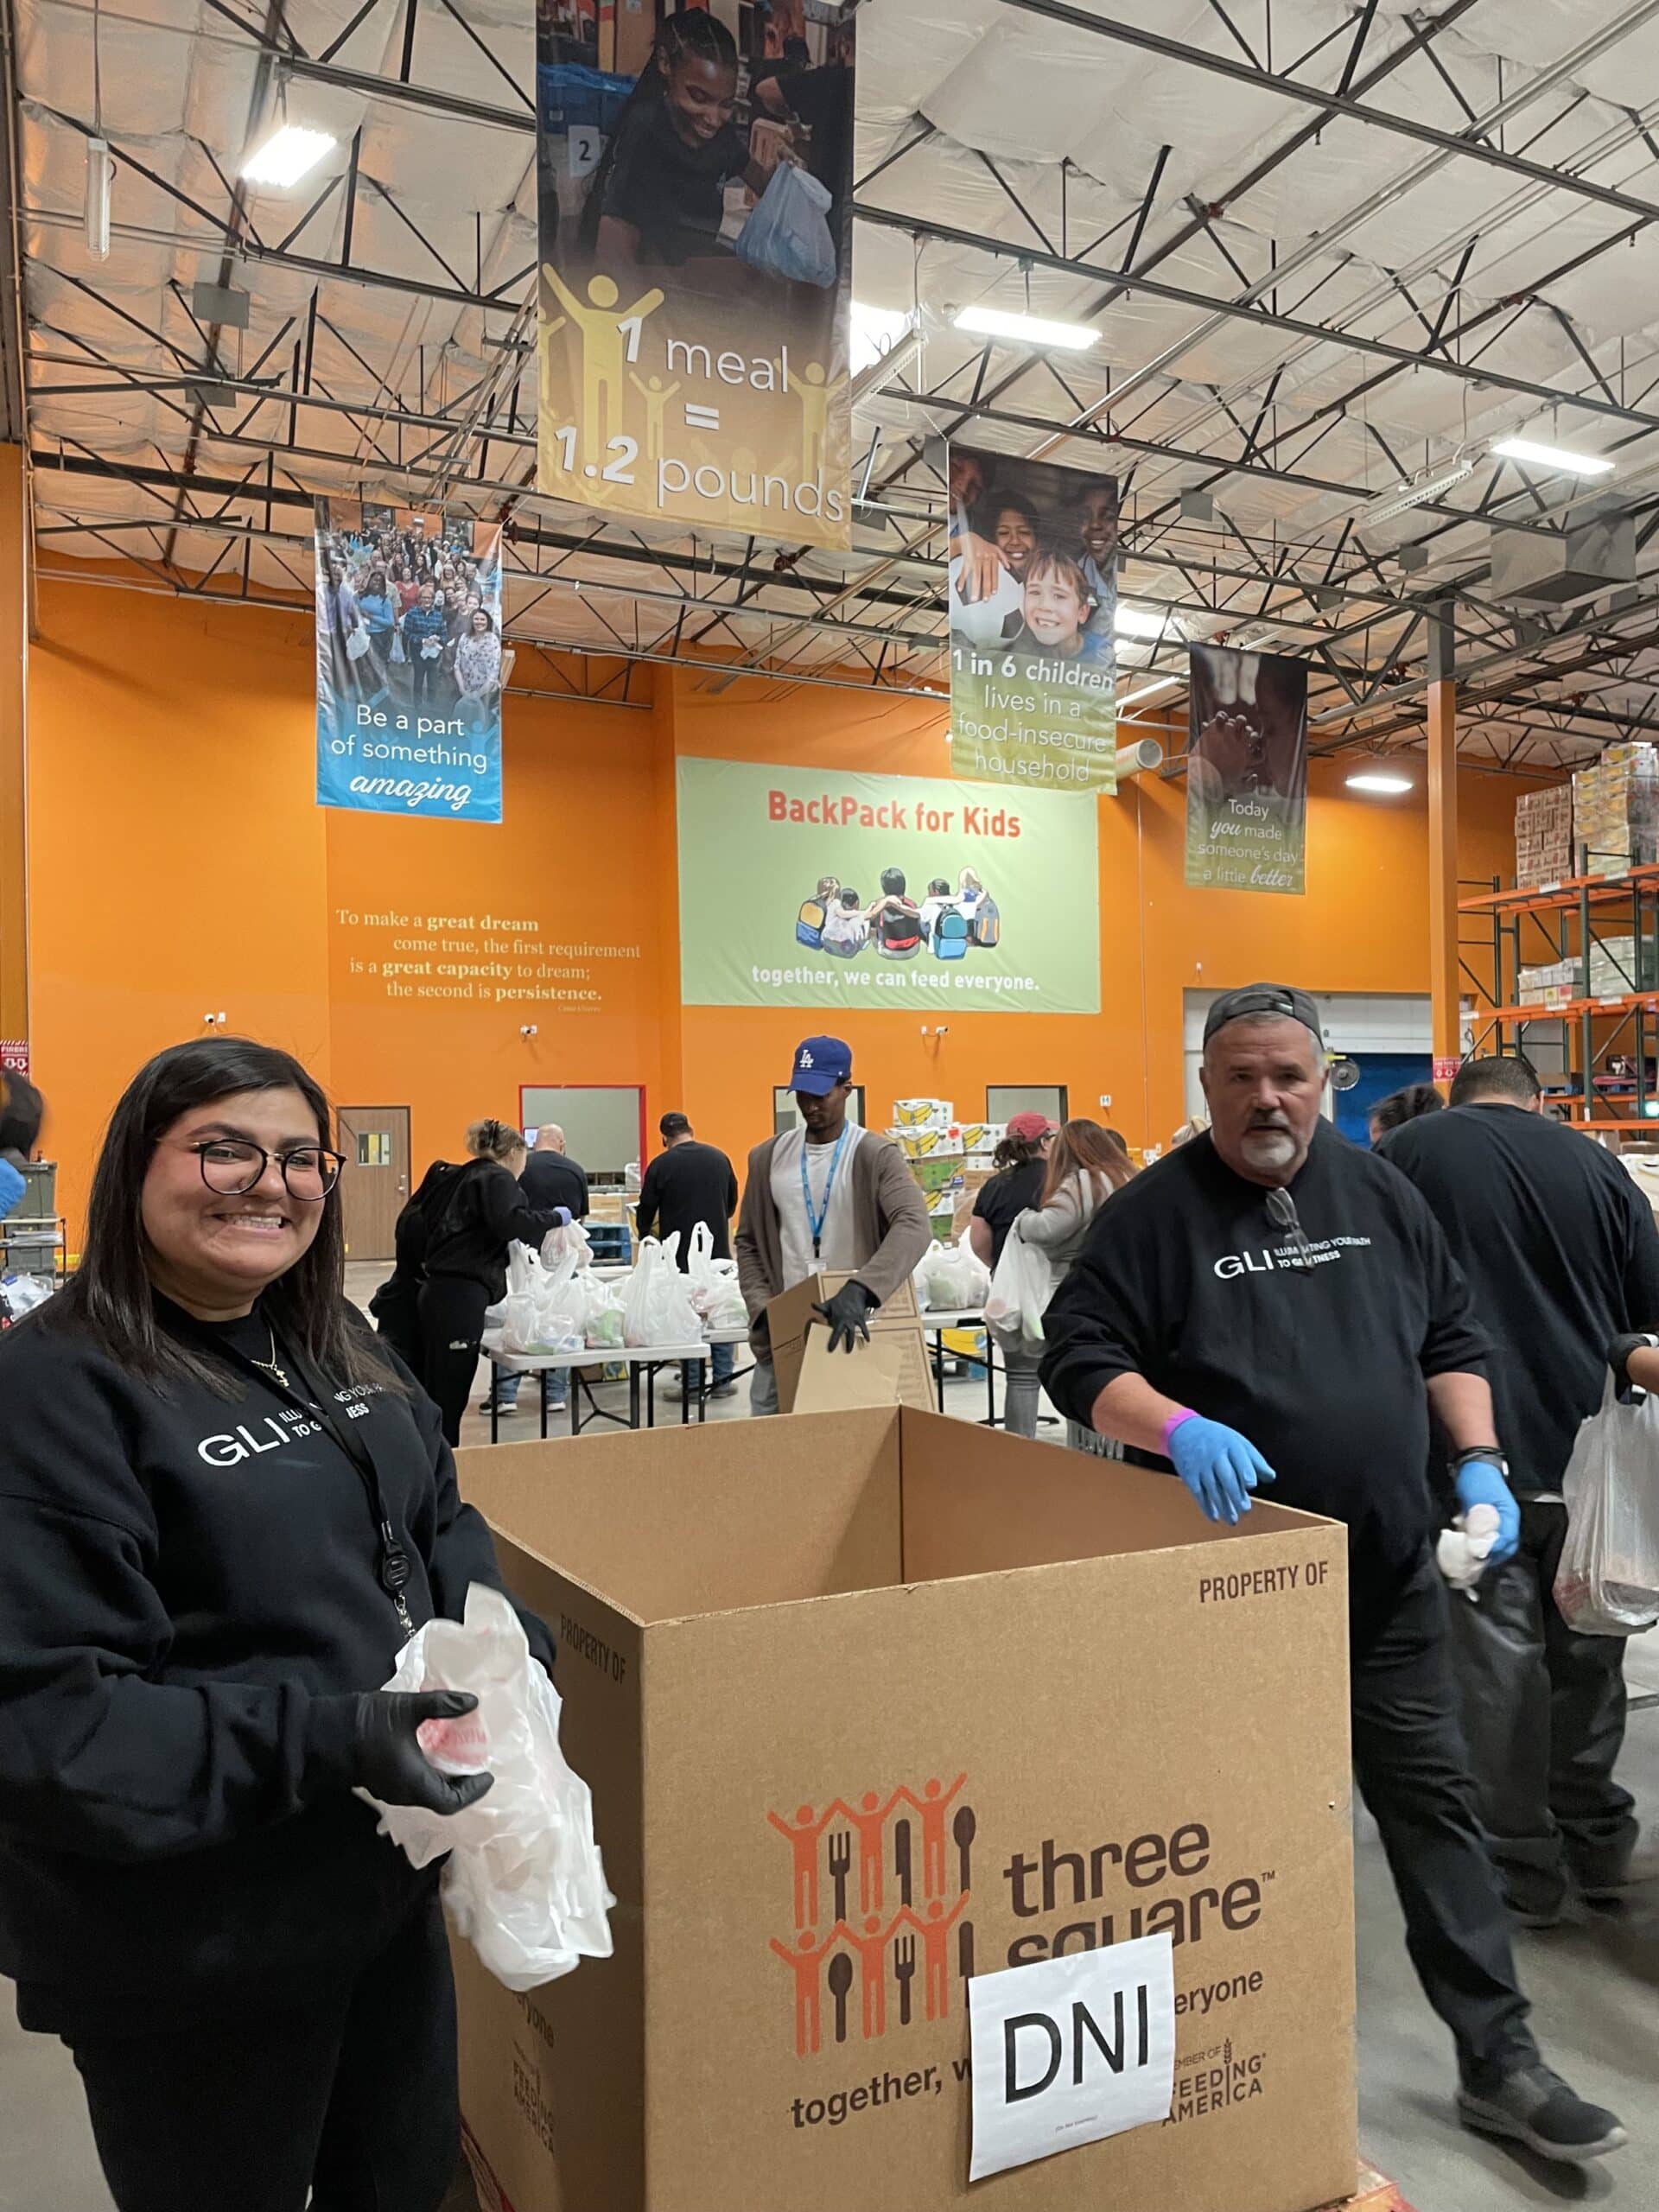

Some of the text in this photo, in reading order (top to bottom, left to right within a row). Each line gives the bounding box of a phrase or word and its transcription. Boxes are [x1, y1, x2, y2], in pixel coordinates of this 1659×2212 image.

[579, 140, 591, 161] 2
[617, 316, 788, 392] 1 meal
[555, 425, 843, 522] 1.2 pounds
[953, 649, 1114, 691] 1 in 6 children
[985, 684, 1080, 716] lives in a
[357, 704, 464, 738] Be a part
[957, 712, 1106, 752] food-insecure
[332, 734, 486, 774] of something
[975, 747, 1090, 781] household
[350, 776, 472, 810] amazing
[768, 790, 1020, 837] BackPack for Kids
[1228, 798, 1269, 822] Today
[1210, 821, 1282, 840] you made
[1198, 843, 1298, 865] someone's day
[1203, 865, 1293, 887] a little better
[336, 909, 539, 931] To make a great dream
[393, 938, 641, 960] come true, the first requirement
[350, 957, 590, 981] is a great capacity to dream;
[752, 965, 1039, 993] together, we can feed everyone.
[387, 981, 602, 1002] the second is persistence.
[799, 1049, 814, 1068] LA
[1213, 1249, 1274, 1279] GLI
[1277, 1259, 1291, 1268] TO
[198, 1417, 290, 1466] GLI
[292, 1423, 311, 1437] TO
[1200, 1560, 1328, 1603] PROPERTY OF
[561, 1612, 626, 1685] PROPERTY OF
[1003, 1823, 1210, 1917] three
[1174, 1969, 1264, 2014] eryone
[1003, 1984, 1149, 2105] DNI
[1175, 2046, 1222, 2070] EMBER OF
[791, 2066, 942, 2128] together,
